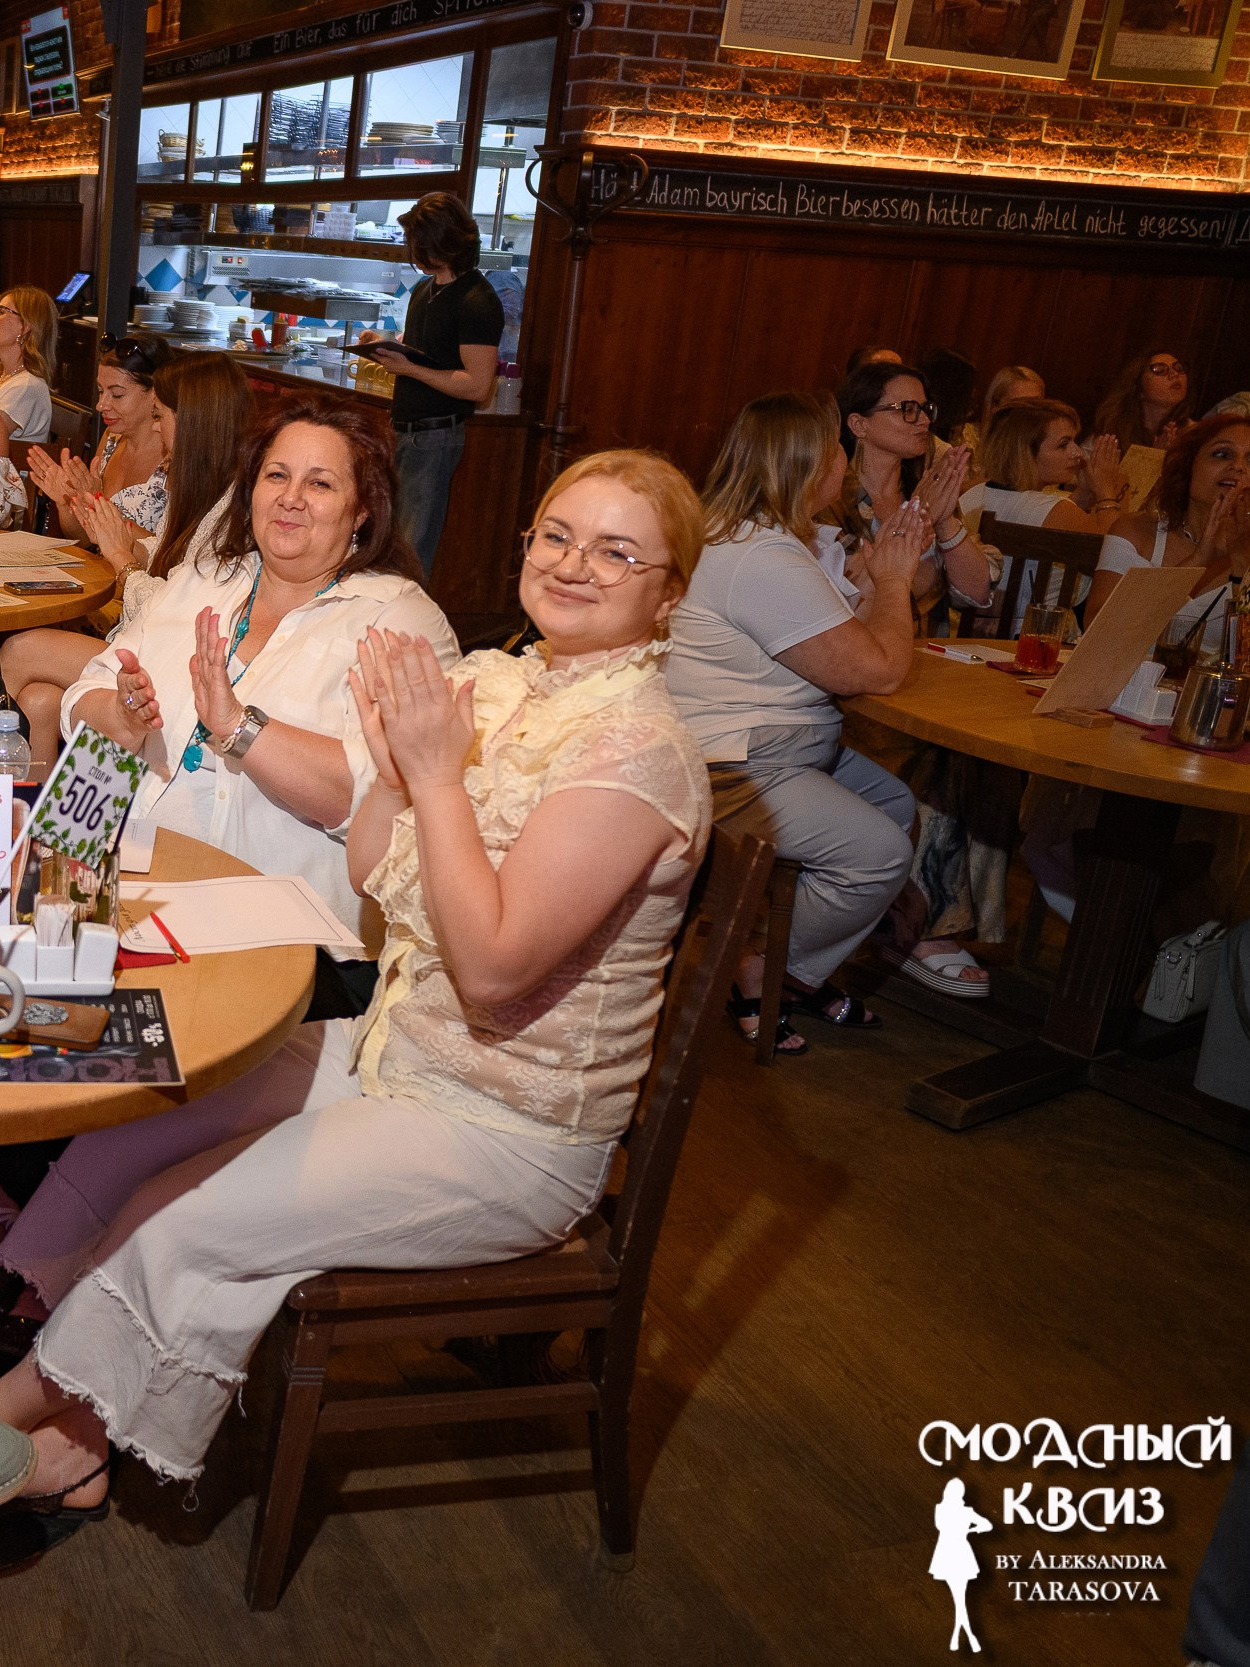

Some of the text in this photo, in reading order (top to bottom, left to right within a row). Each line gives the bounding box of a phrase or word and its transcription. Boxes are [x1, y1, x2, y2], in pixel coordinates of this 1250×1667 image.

[273, 32, 291, 53] Ein
[295, 27, 323, 49] Bier,
[328, 21, 348, 39] das
[355, 11, 382, 35] für
[390, 4, 418, 27] dich
[646, 173, 700, 206] Adam
[706, 175, 788, 215] bayrisch
[996, 200, 1028, 230] den
[1085, 205, 1127, 236] nicht
[88, 766, 105, 783] СТОЛ
[58, 774, 112, 831] 506
